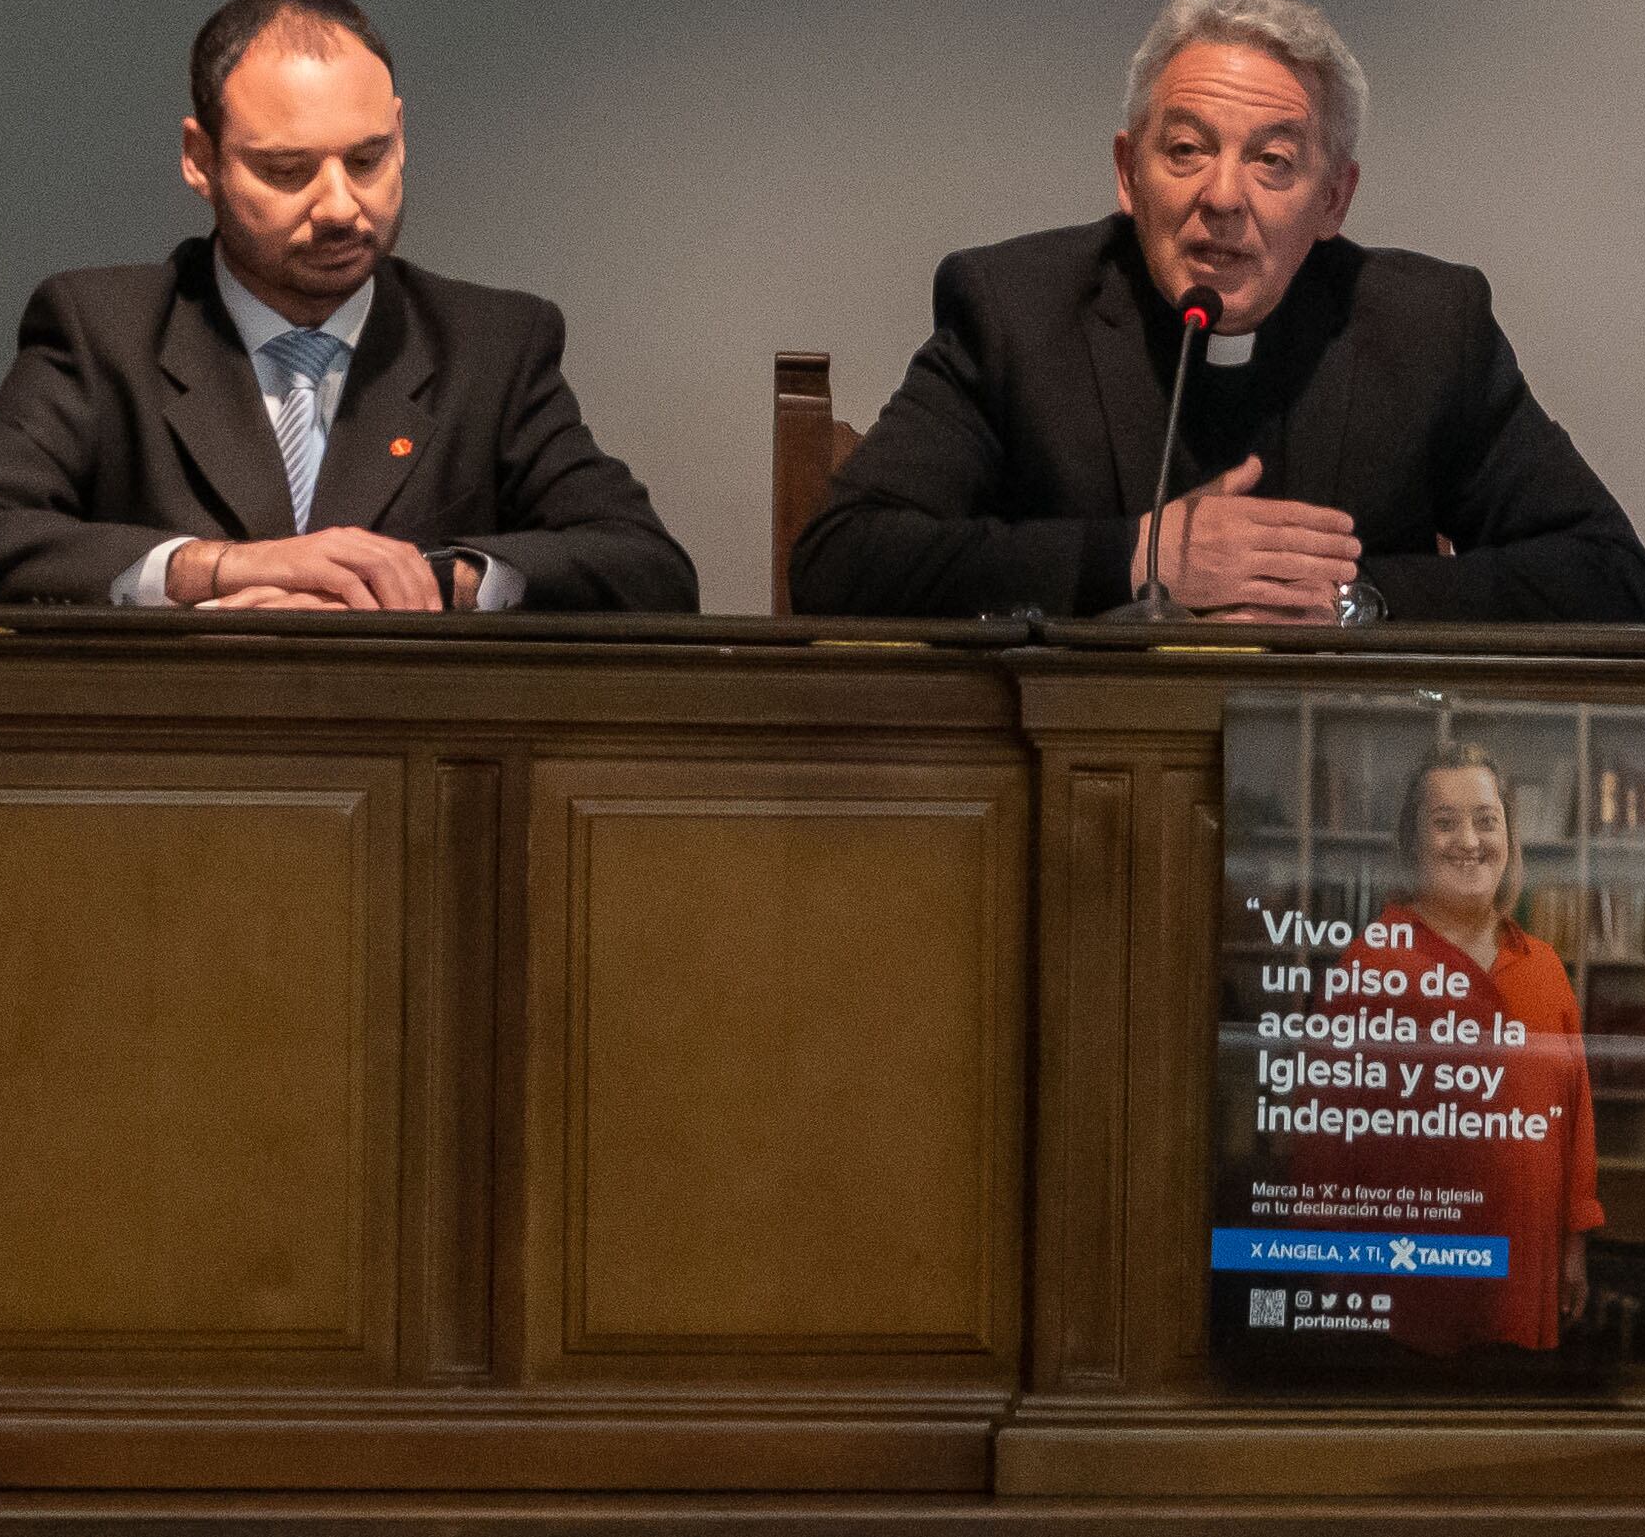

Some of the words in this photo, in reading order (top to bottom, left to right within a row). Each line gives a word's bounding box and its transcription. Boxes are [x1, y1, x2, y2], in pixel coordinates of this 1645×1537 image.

[1364, 920, 1413, 950] en
[1262, 965, 1311, 992] un
[1324, 960, 1407, 1002] piso
[1420, 964, 1470, 999] de
[1258, 1007, 1417, 1049] acogida
[1429, 1011, 1479, 1045] de
[1494, 1014, 1526, 1047] la
[1258, 1050, 1387, 1095] Iglesia
[1400, 1062, 1424, 1096] y
[1434, 1064, 1504, 1101] soy
[1252, 1182, 1297, 1198] Marca
[1303, 1183, 1314, 1198] la
[1342, 1188, 1351, 1199] a
[1355, 1186, 1390, 1200] favor
[1396, 1187, 1415, 1201] de
[1420, 1188, 1432, 1201] la
[1437, 1188, 1483, 1204] Iglesia
[1252, 1202, 1270, 1214] en
[1275, 1201, 1289, 1214] tu
[1293, 1201, 1378, 1217] declaración
[1383, 1204, 1402, 1218] de
[1406, 1204, 1419, 1218] la
[1423, 1206, 1461, 1220] renta
[1251, 1242, 1263, 1258] X
[1268, 1240, 1343, 1263] ÁNGELA,
[1348, 1245, 1361, 1261] X
[1294, 1314, 1390, 1330] portantos.es
